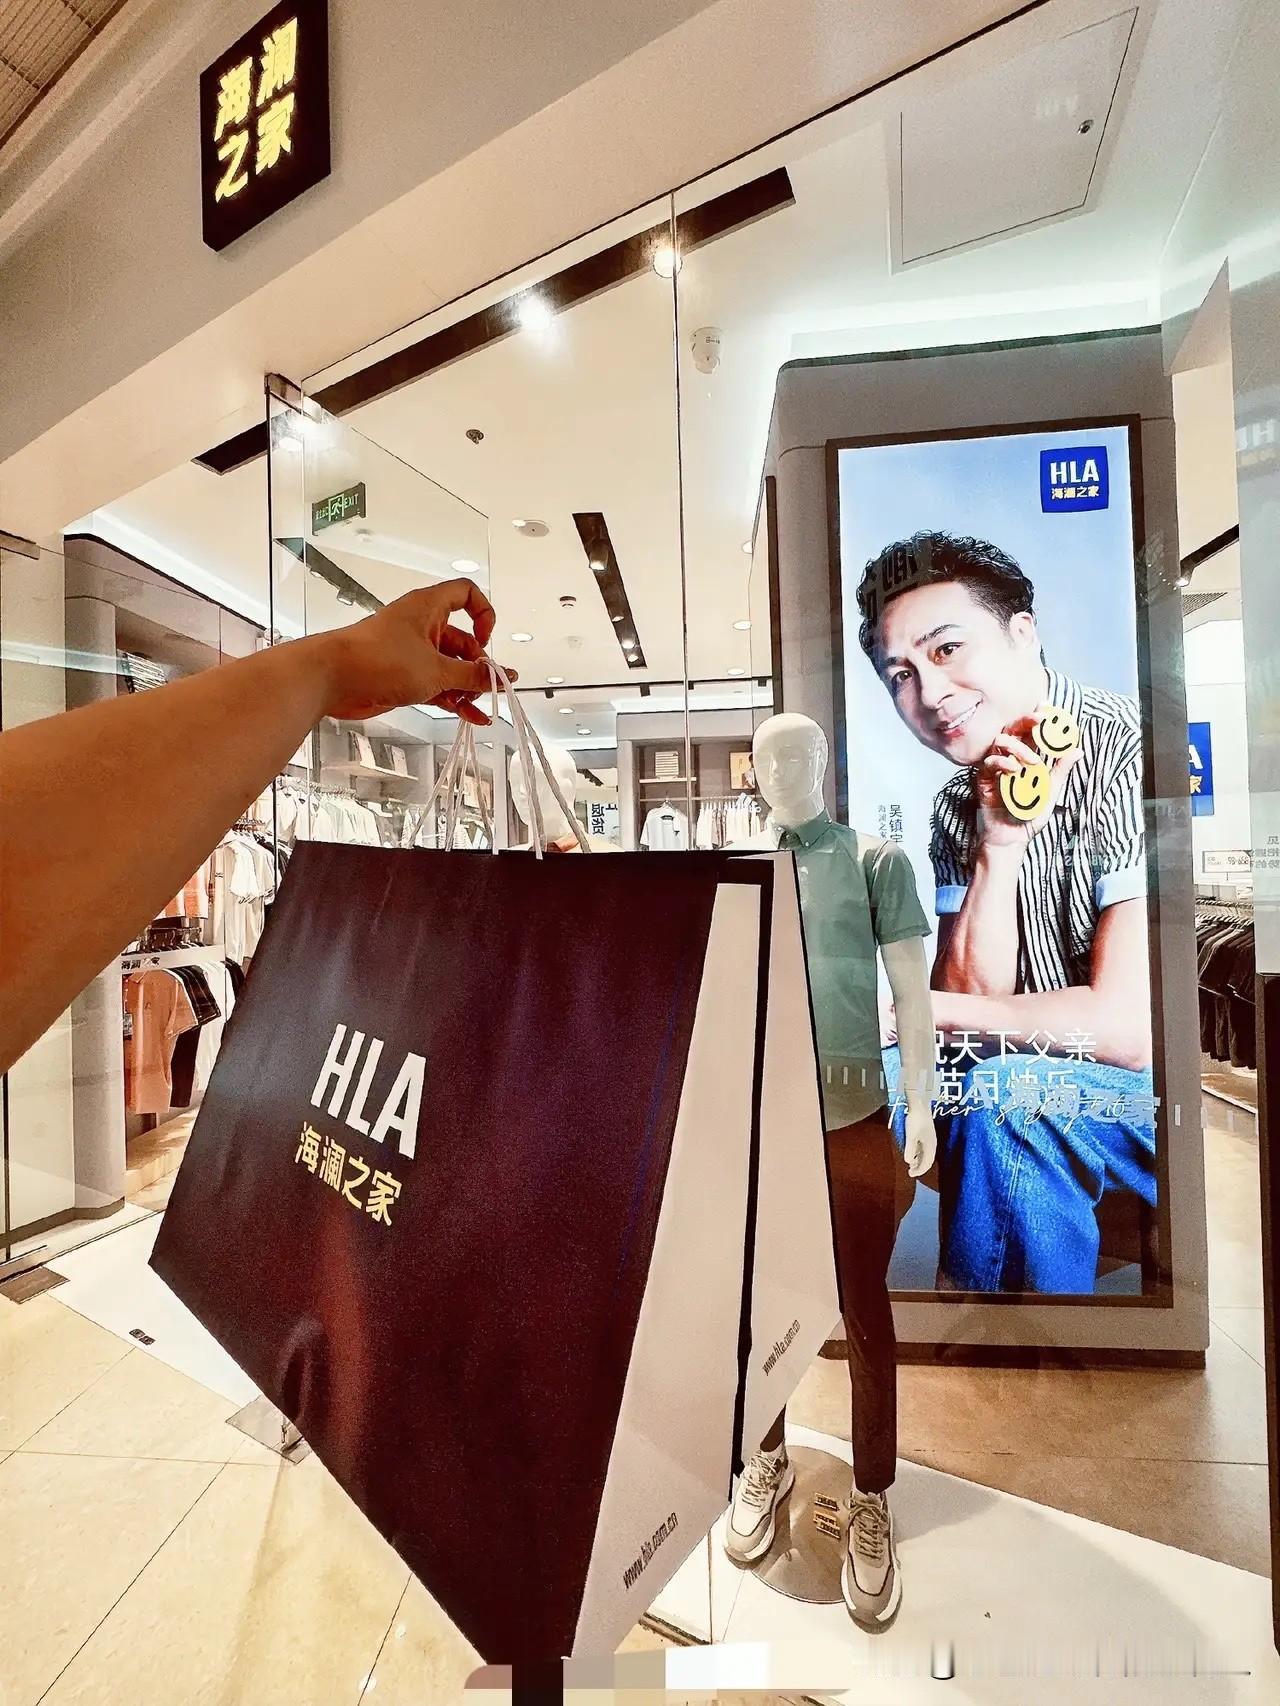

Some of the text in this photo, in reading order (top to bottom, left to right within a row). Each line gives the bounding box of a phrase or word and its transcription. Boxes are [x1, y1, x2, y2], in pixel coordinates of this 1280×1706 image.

[214, 17, 298, 142] 海澜
[215, 92, 295, 204] 之家
[1050, 459, 1099, 484] HLA
[1051, 485, 1099, 500] 海澜之家
[310, 1023, 427, 1160] HLA
[295, 1121, 402, 1226] 海澜之家
